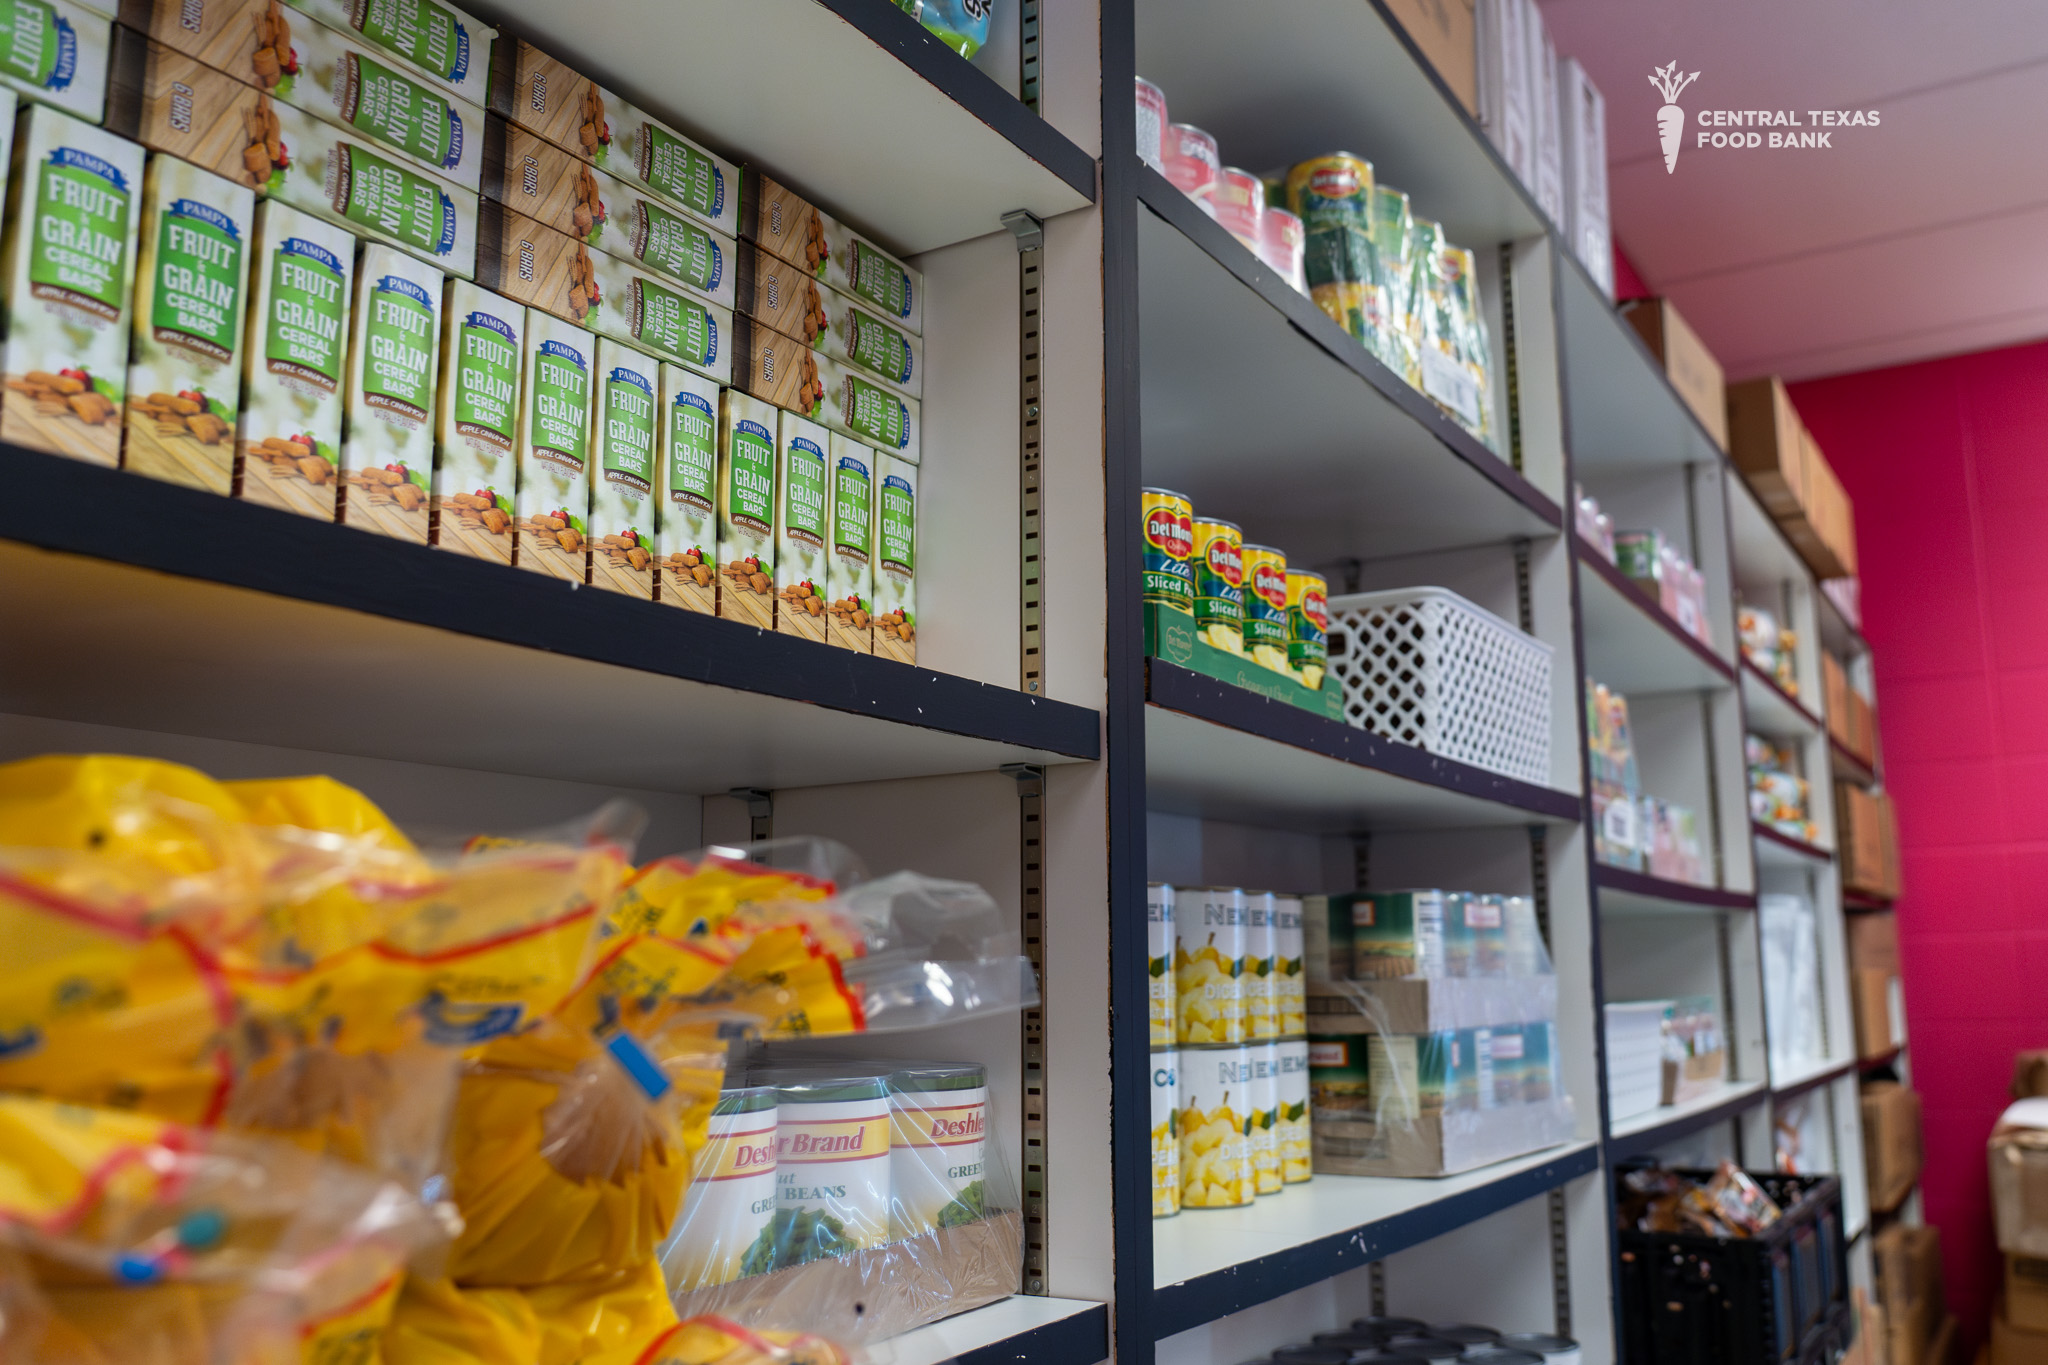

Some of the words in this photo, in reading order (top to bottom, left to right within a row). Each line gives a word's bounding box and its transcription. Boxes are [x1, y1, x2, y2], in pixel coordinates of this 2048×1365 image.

[9, 1, 44, 78] FRUIT
[427, 10, 448, 72] FRUIT
[456, 35, 468, 74] PAMPA
[362, 79, 375, 117] BARS
[373, 76, 388, 127] CEREAL
[386, 79, 410, 145] GRAIN
[532, 82, 547, 114] BARS
[171, 94, 193, 133] BARS
[419, 97, 441, 158] FRUIT
[450, 120, 461, 159] PAMPA
[64, 150, 115, 179] PAMPA
[654, 146, 663, 175] BARS
[662, 142, 672, 185] CEREAL
[671, 144, 687, 200] GRAIN
[354, 169, 367, 207] BARS
[366, 165, 380, 217] CEREAL
[523, 165, 538, 197] BARS
[693, 158, 708, 210] FRUIT
[714, 177, 724, 210] PAMPA
[48, 174, 123, 222] FRUIT
[379, 168, 403, 235] GRAIN
[183, 202, 227, 228] PAMPA
[412, 184, 433, 246] FRUIT
[443, 205, 454, 245] PAMPA
[771, 209, 782, 236] BARS
[41, 215, 121, 265] GRAIN
[169, 224, 235, 269] FRUIT
[650, 221, 661, 253] BARS
[657, 217, 668, 261] CEREAL
[667, 220, 684, 275] GRAIN
[44, 247, 112, 281] CEREAL
[293, 241, 332, 266] PAMPA
[519, 249, 534, 282] BARS
[689, 231, 706, 284] FRUIT
[711, 249, 721, 288] PAMPA
[58, 267, 103, 293] BARS
[163, 263, 234, 310] GRAIN
[280, 262, 339, 303] FRUIT
[389, 277, 424, 300] PAMPA
[166, 293, 225, 325] CEREAL
[768, 282, 779, 310] BARS
[178, 312, 217, 337] BARS
[276, 299, 339, 341] GRAIN
[376, 299, 430, 337] FRUIT
[476, 314, 508, 334] PAMPA
[646, 300, 656, 331] BARS
[654, 294, 663, 339] CEREAL
[664, 296, 679, 352] GRAIN
[279, 327, 331, 357] CEREAL
[687, 307, 702, 359] FRUIT
[708, 323, 717, 363] PAMPA
[872, 324, 884, 371] GRAIN
[290, 344, 324, 367] BARS
[371, 335, 429, 374] GRAIN
[466, 334, 513, 370] FRUIT
[549, 343, 579, 361] PAMPA
[889, 334, 901, 377] FRUIT
[373, 362, 421, 388] CEREAL
[540, 362, 584, 395] FRUIT
[618, 370, 645, 387] PAMPA
[764, 356, 774, 383] BARS
[383, 379, 415, 399] BARS
[463, 368, 513, 404] GRAIN
[465, 392, 507, 417] CEREAL
[538, 394, 584, 428] GRAIN
[611, 388, 650, 419] FRUIT
[683, 394, 707, 410] PAMPA
[862, 388, 870, 427] CEREAL
[869, 389, 880, 437] GRAIN
[474, 408, 502, 428] BARS
[541, 417, 579, 441] CEREAL
[676, 412, 711, 441] FRUIT
[743, 422, 766, 437] PAMPA
[886, 398, 898, 443] FRUIT
[549, 434, 574, 451] BARS
[609, 419, 650, 452] GRAIN
[797, 439, 818, 454] PAMPA
[612, 441, 646, 464] CEREAL
[619, 456, 642, 473] BARS
[675, 441, 712, 472] GRAIN
[736, 439, 770, 467] FRUIT
[844, 458, 864, 472] PAMPA
[677, 463, 709, 484] CEREAL
[735, 467, 770, 497] GRAIN
[791, 455, 823, 483] FRUIT
[889, 477, 908, 491] PAMPA
[684, 477, 705, 493] BARS
[737, 488, 767, 508] CEREAL
[790, 482, 823, 511] GRAIN
[839, 474, 868, 500] FRUIT
[743, 501, 763, 517] BARS
[792, 502, 819, 521] CEREAL
[838, 501, 869, 527] GRAIN
[884, 493, 911, 517] FRUIT
[798, 514, 816, 530] BARS
[840, 520, 865, 538] CEREAL
[883, 519, 912, 543] GRAIN
[1150, 521, 1169, 536] Del
[845, 531, 862, 546] BARS
[885, 537, 910, 553] CEREAL
[891, 548, 907, 561] BARS
[1160, 559, 1190, 577] Lite
[1211, 549, 1228, 564] Del
[1147, 575, 1181, 592] Sliced
[1256, 574, 1271, 589] Del
[1209, 600, 1237, 617] Sliced
[1254, 622, 1281, 638] Sliced
[791, 1126, 866, 1154] Brand
[785, 1185, 846, 1200] BEANS
